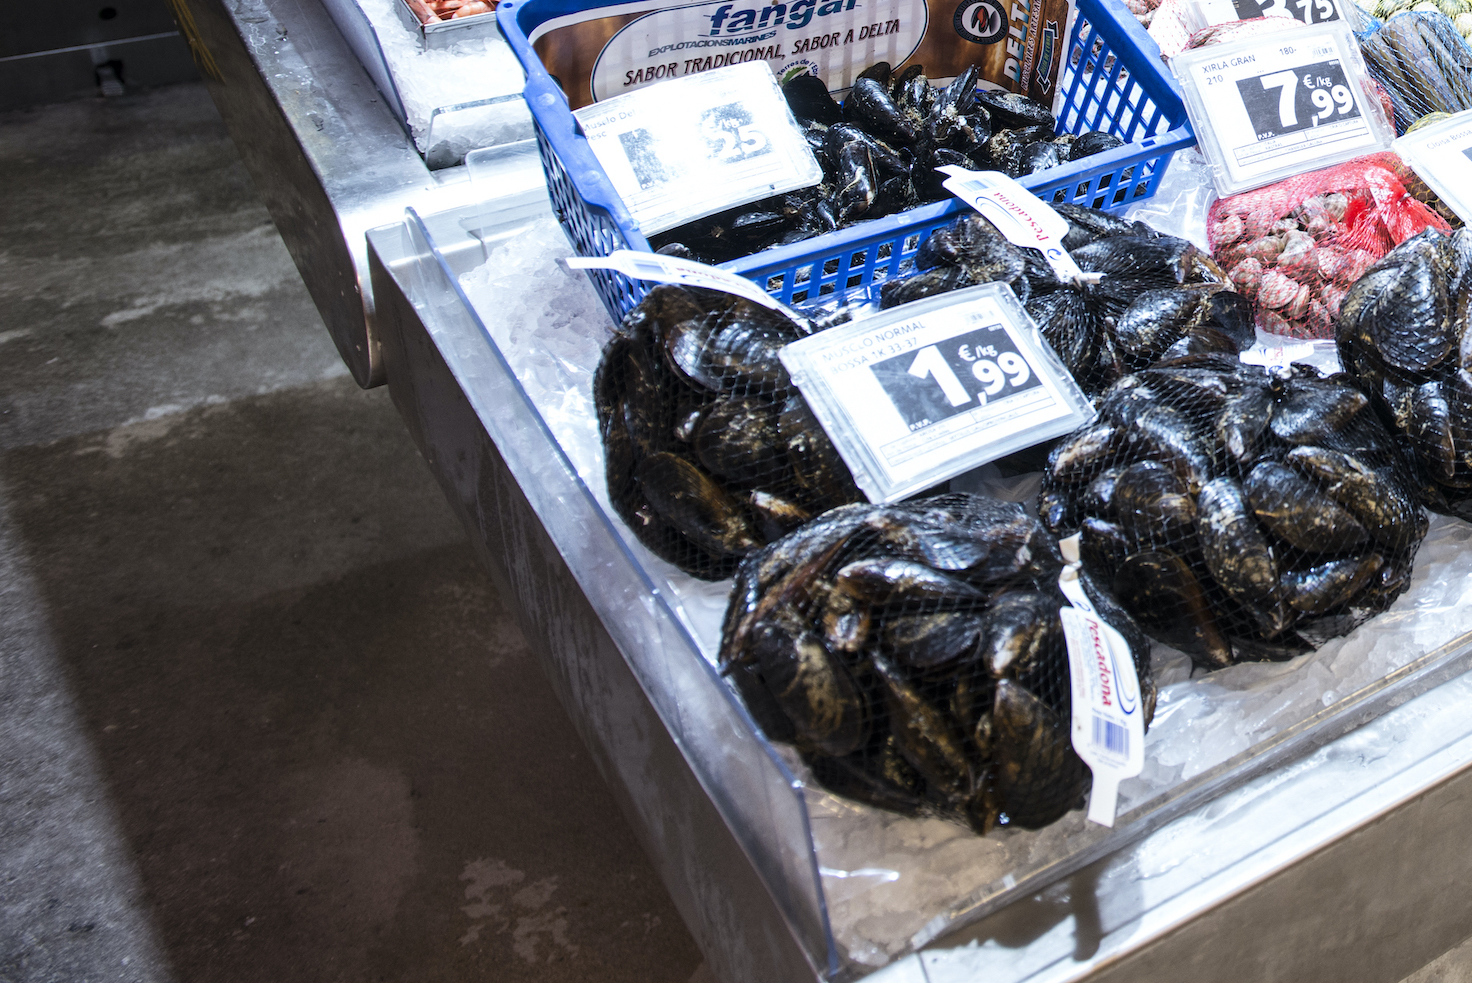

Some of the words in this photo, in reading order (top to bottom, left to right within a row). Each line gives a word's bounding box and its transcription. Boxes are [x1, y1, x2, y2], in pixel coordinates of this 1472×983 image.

[623, 61, 678, 87] SABOR
[683, 45, 786, 75] TRADICIONAL,
[791, 32, 840, 56] SABOR
[843, 29, 854, 44] A
[858, 18, 900, 41] DELTA
[1202, 60, 1230, 74] XIRLA
[1230, 54, 1256, 67] GRAN
[1279, 46, 1297, 56] 180-
[1206, 74, 1224, 85] 210
[1260, 70, 1354, 128] 7,99
[1257, 131, 1275, 140] P.V.P.
[1450, 128, 1472, 142] Bossa
[994, 192, 1049, 241] Pescadona
[823, 337, 873, 363] MUSCLO
[875, 321, 926, 343] NORMAL
[830, 355, 869, 375] BOSSA
[871, 349, 886, 359] 1K
[887, 337, 918, 354] 33-37
[907, 345, 1030, 406] 1,99
[910, 419, 932, 431] P.V.P.
[1085, 618, 1112, 707] Pescadona
